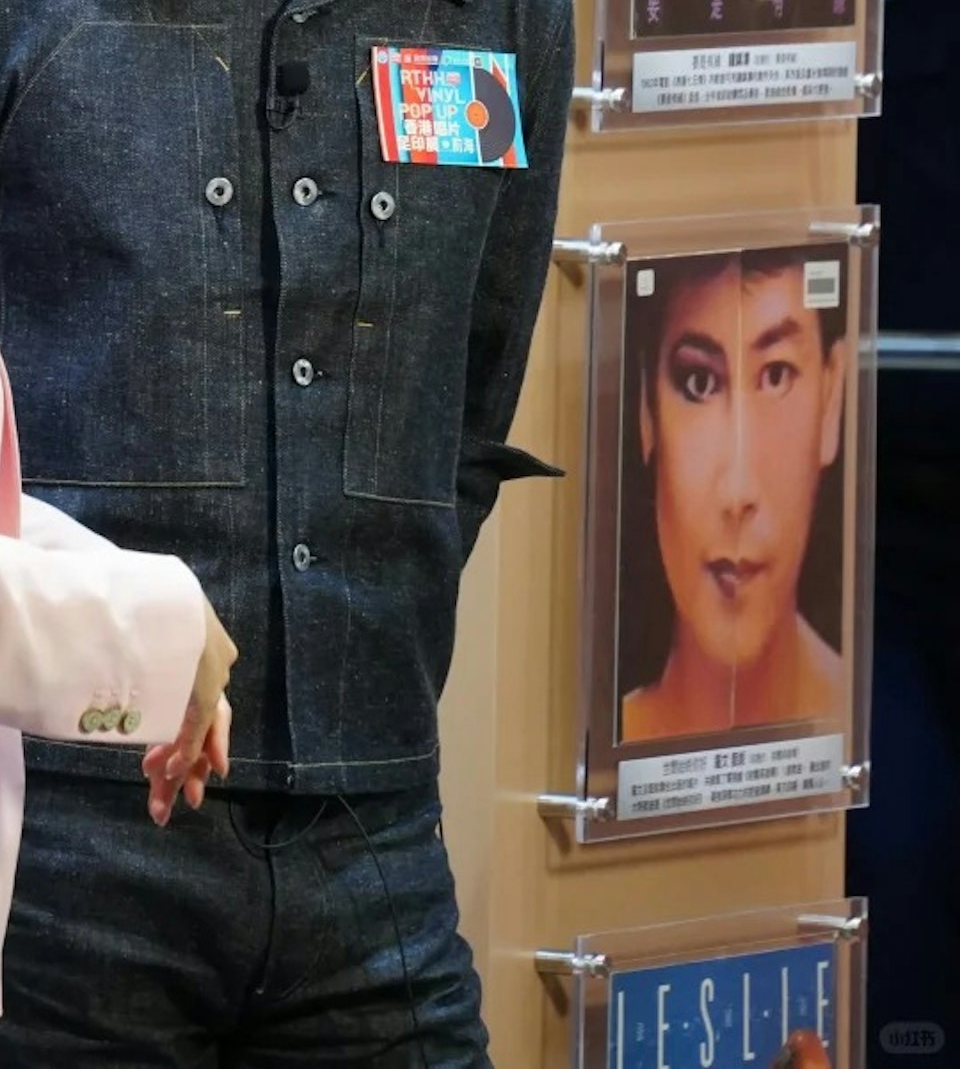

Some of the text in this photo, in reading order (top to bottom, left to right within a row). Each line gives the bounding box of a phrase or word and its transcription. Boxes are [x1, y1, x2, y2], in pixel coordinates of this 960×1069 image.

[416, 87, 466, 104] VINYL
[400, 103, 458, 120] POP UP
